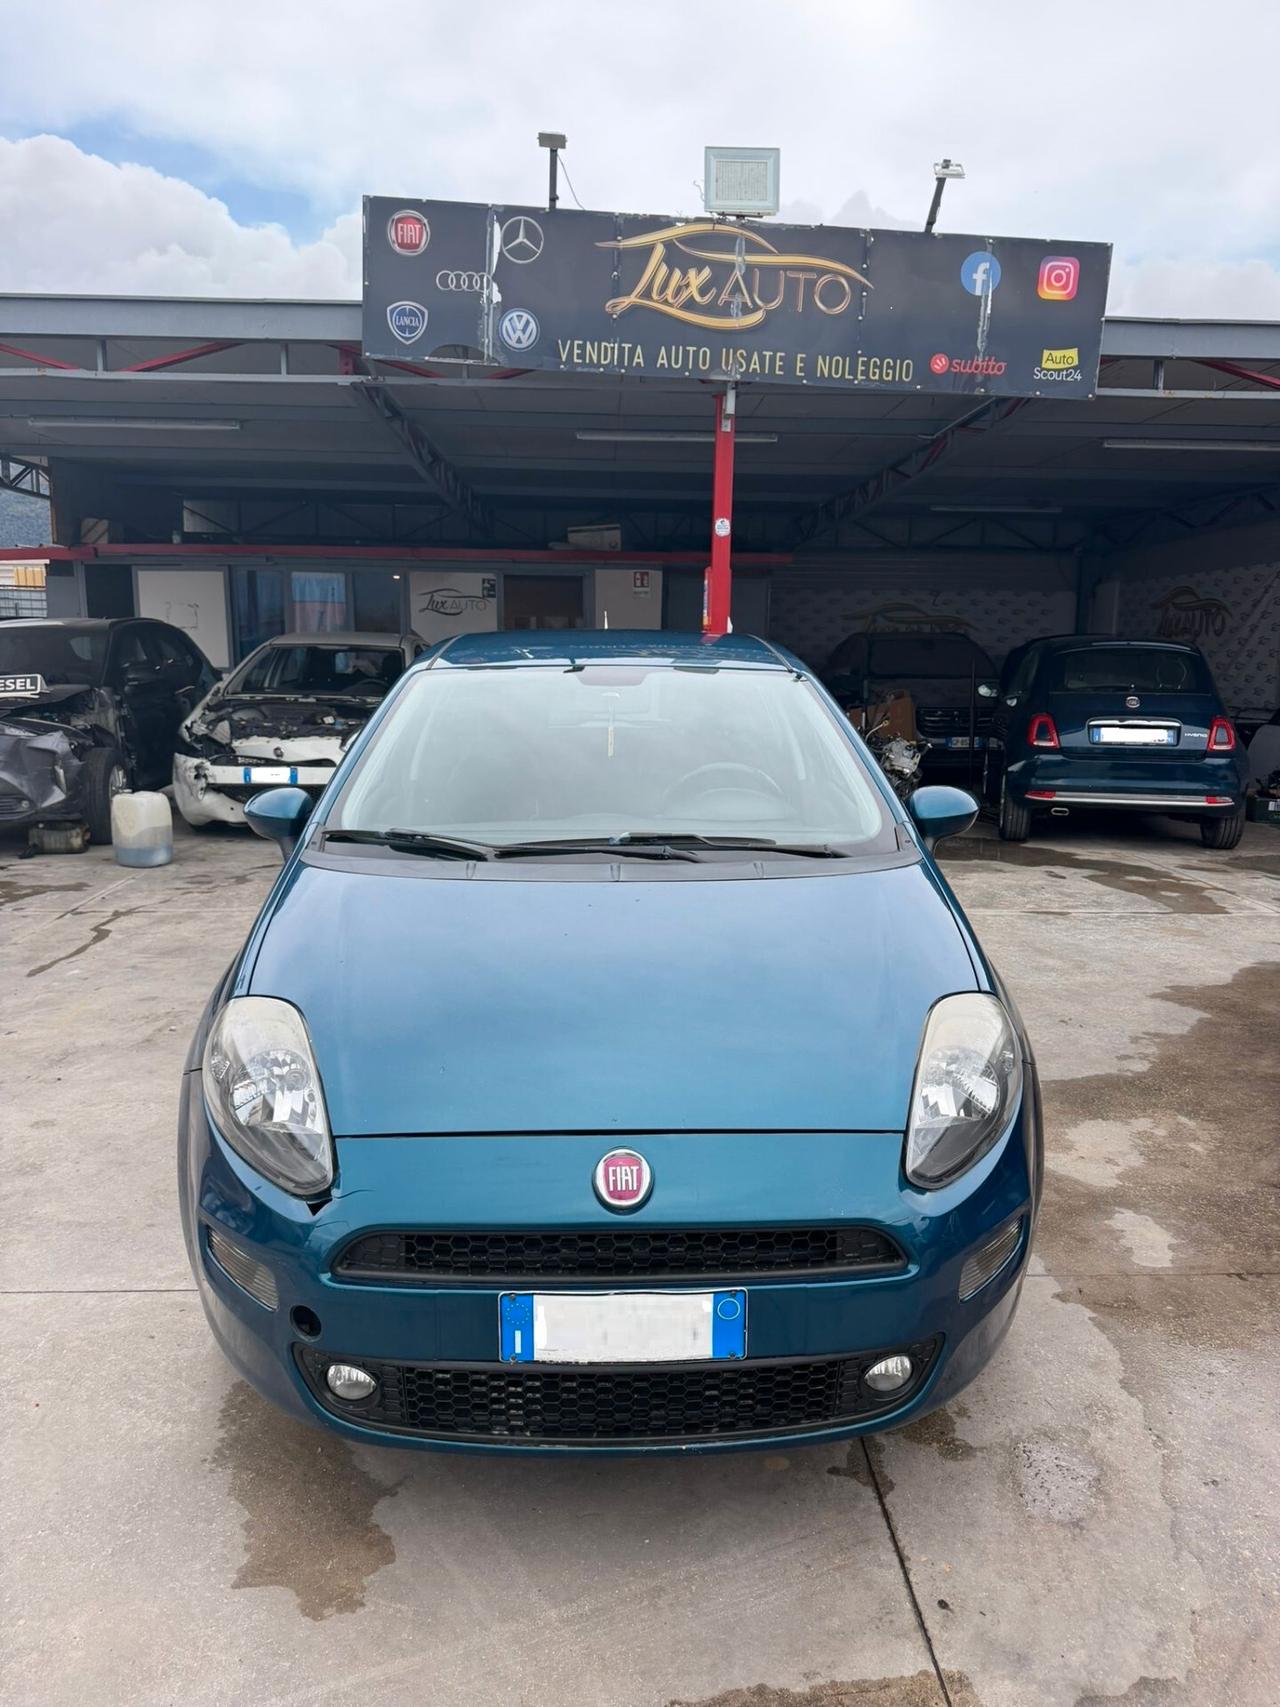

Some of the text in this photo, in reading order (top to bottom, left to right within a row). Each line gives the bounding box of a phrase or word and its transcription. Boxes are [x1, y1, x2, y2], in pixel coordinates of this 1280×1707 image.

[397, 223, 422, 244] FIAT
[395, 315, 420, 327] LANCIA
[558, 339, 914, 382] VENDITA AUTO USATE E NOLEGGIO
[950, 355, 1007, 375] subito
[1044, 352, 1074, 366] Auto
[1033, 367, 1083, 382] Scout24
[608, 1165, 639, 1192] FIAT
